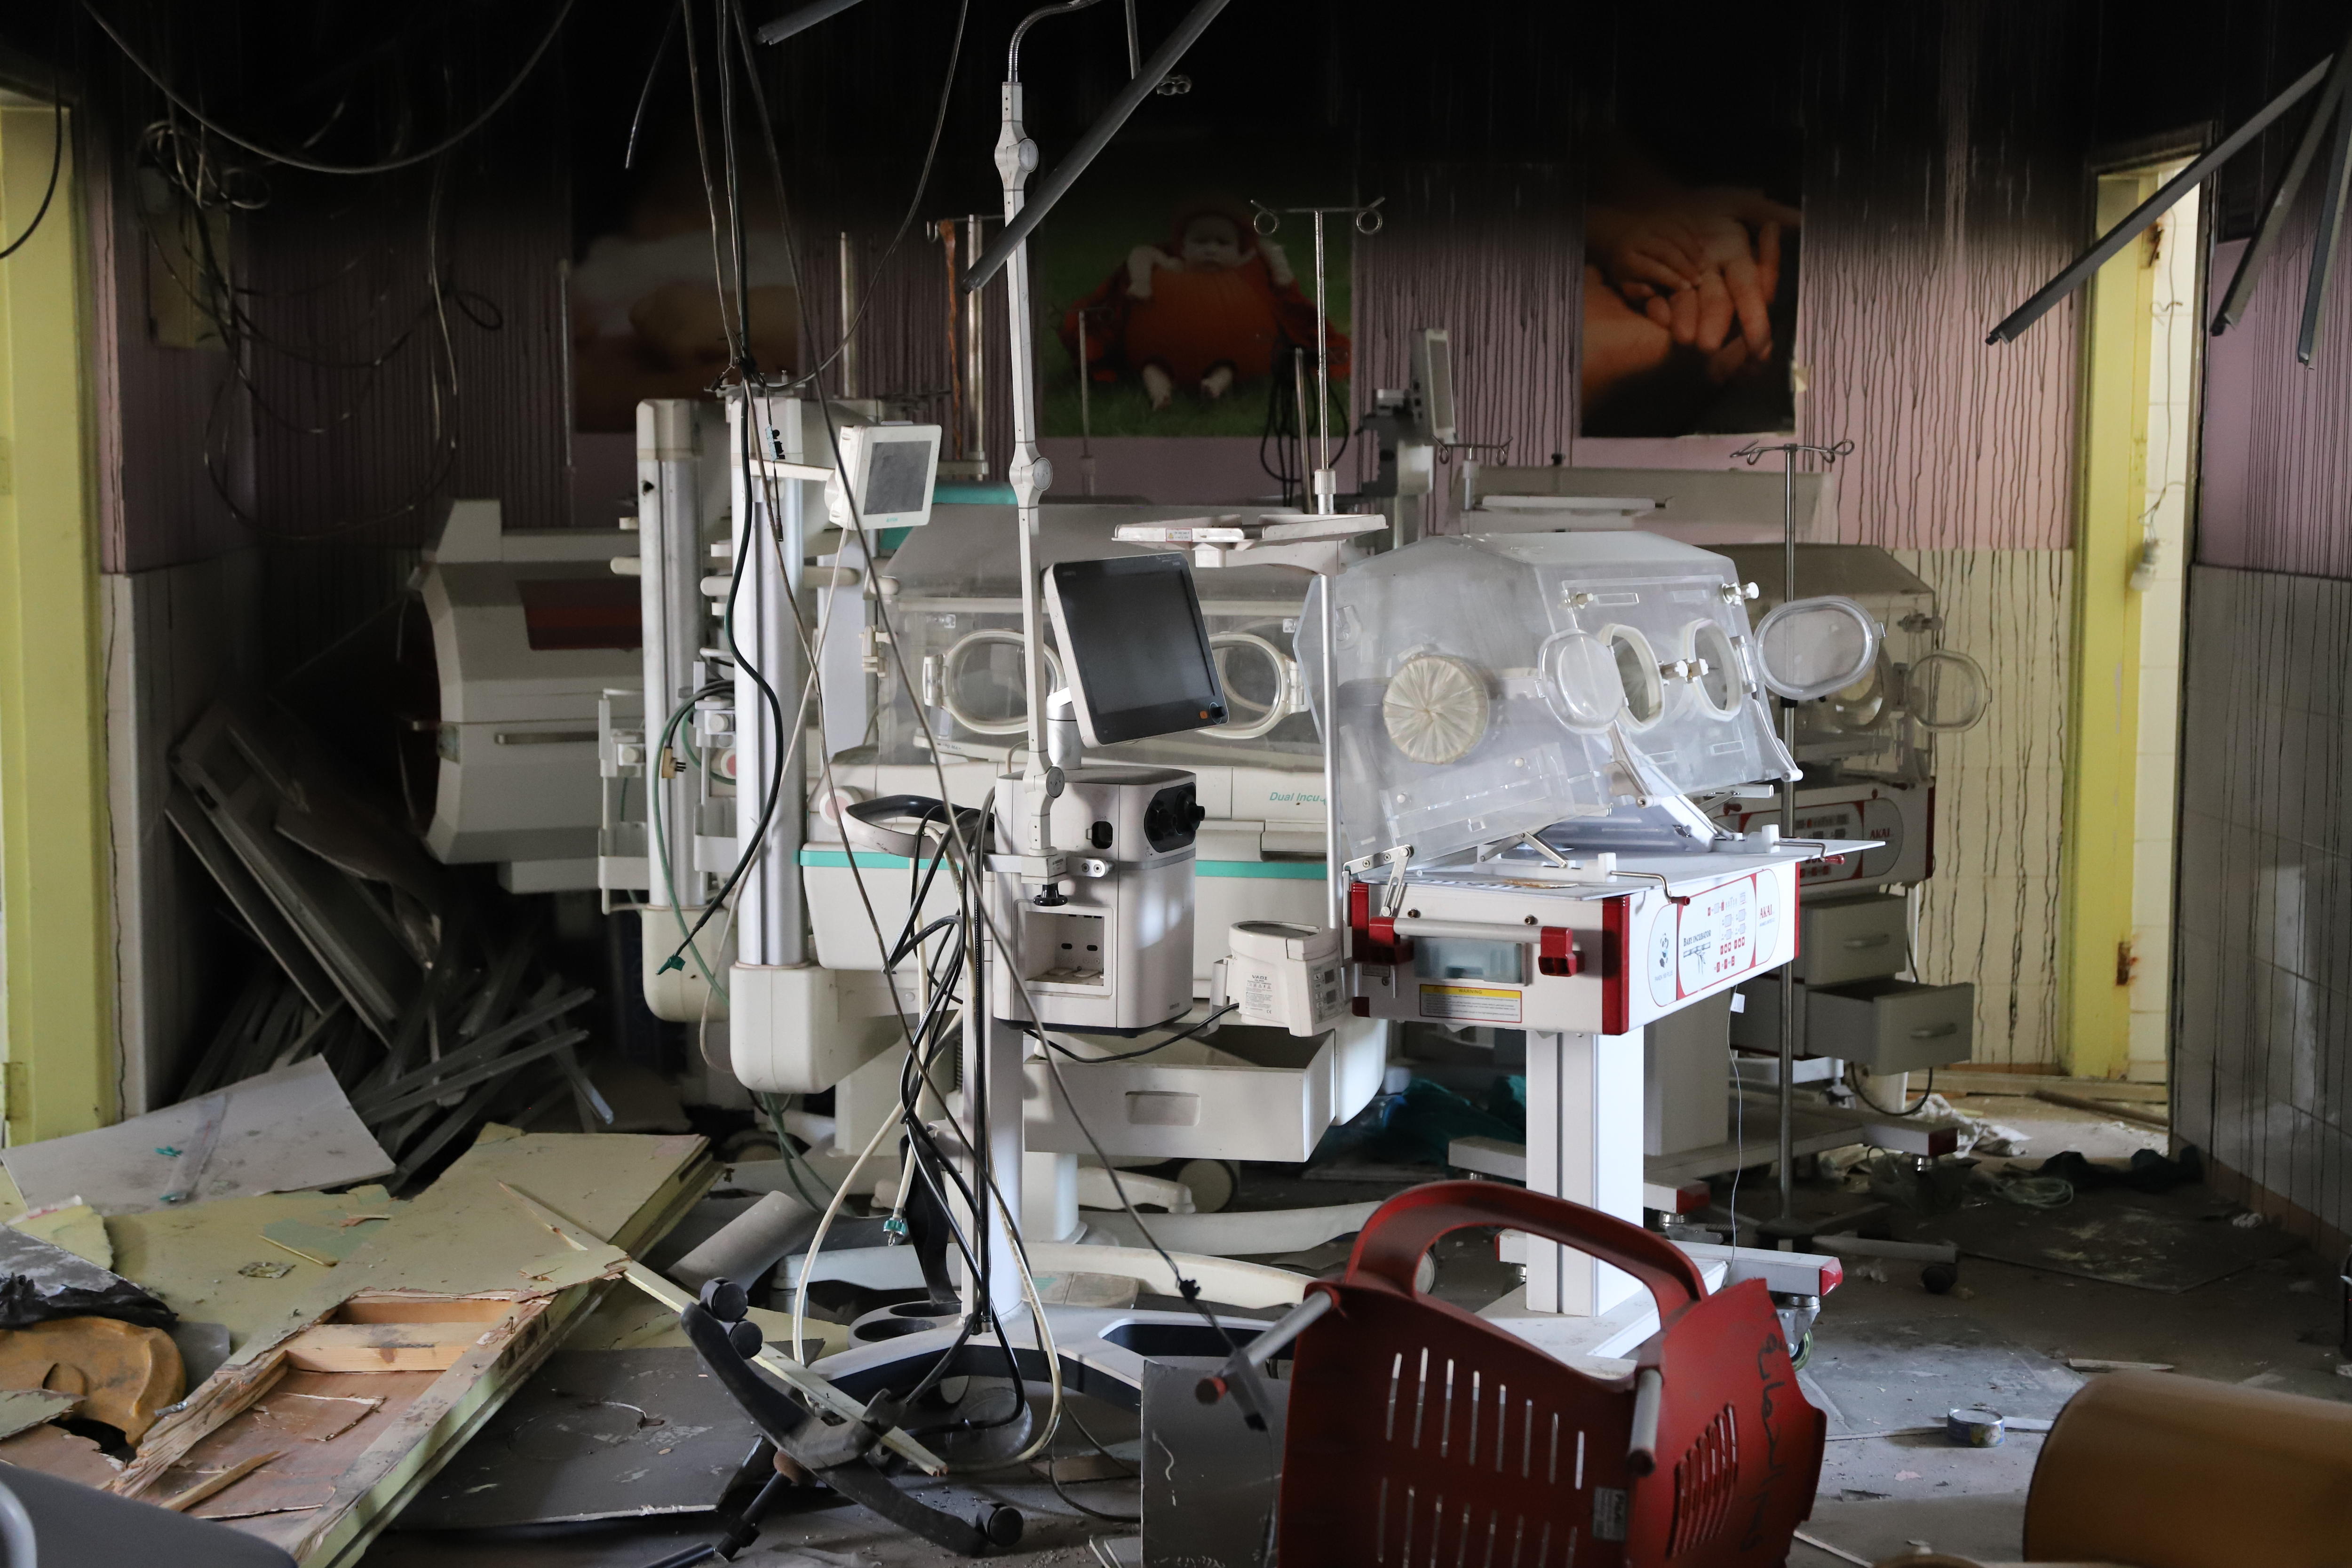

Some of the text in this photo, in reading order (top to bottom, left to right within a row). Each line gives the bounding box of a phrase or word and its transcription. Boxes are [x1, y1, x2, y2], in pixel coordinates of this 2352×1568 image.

[1270, 792, 1295, 801] Dual
[1869, 828, 1890, 840] AKAI
[1759, 904, 1772, 920] AKAI
[1693, 930, 1711, 943] INCUBATOR
